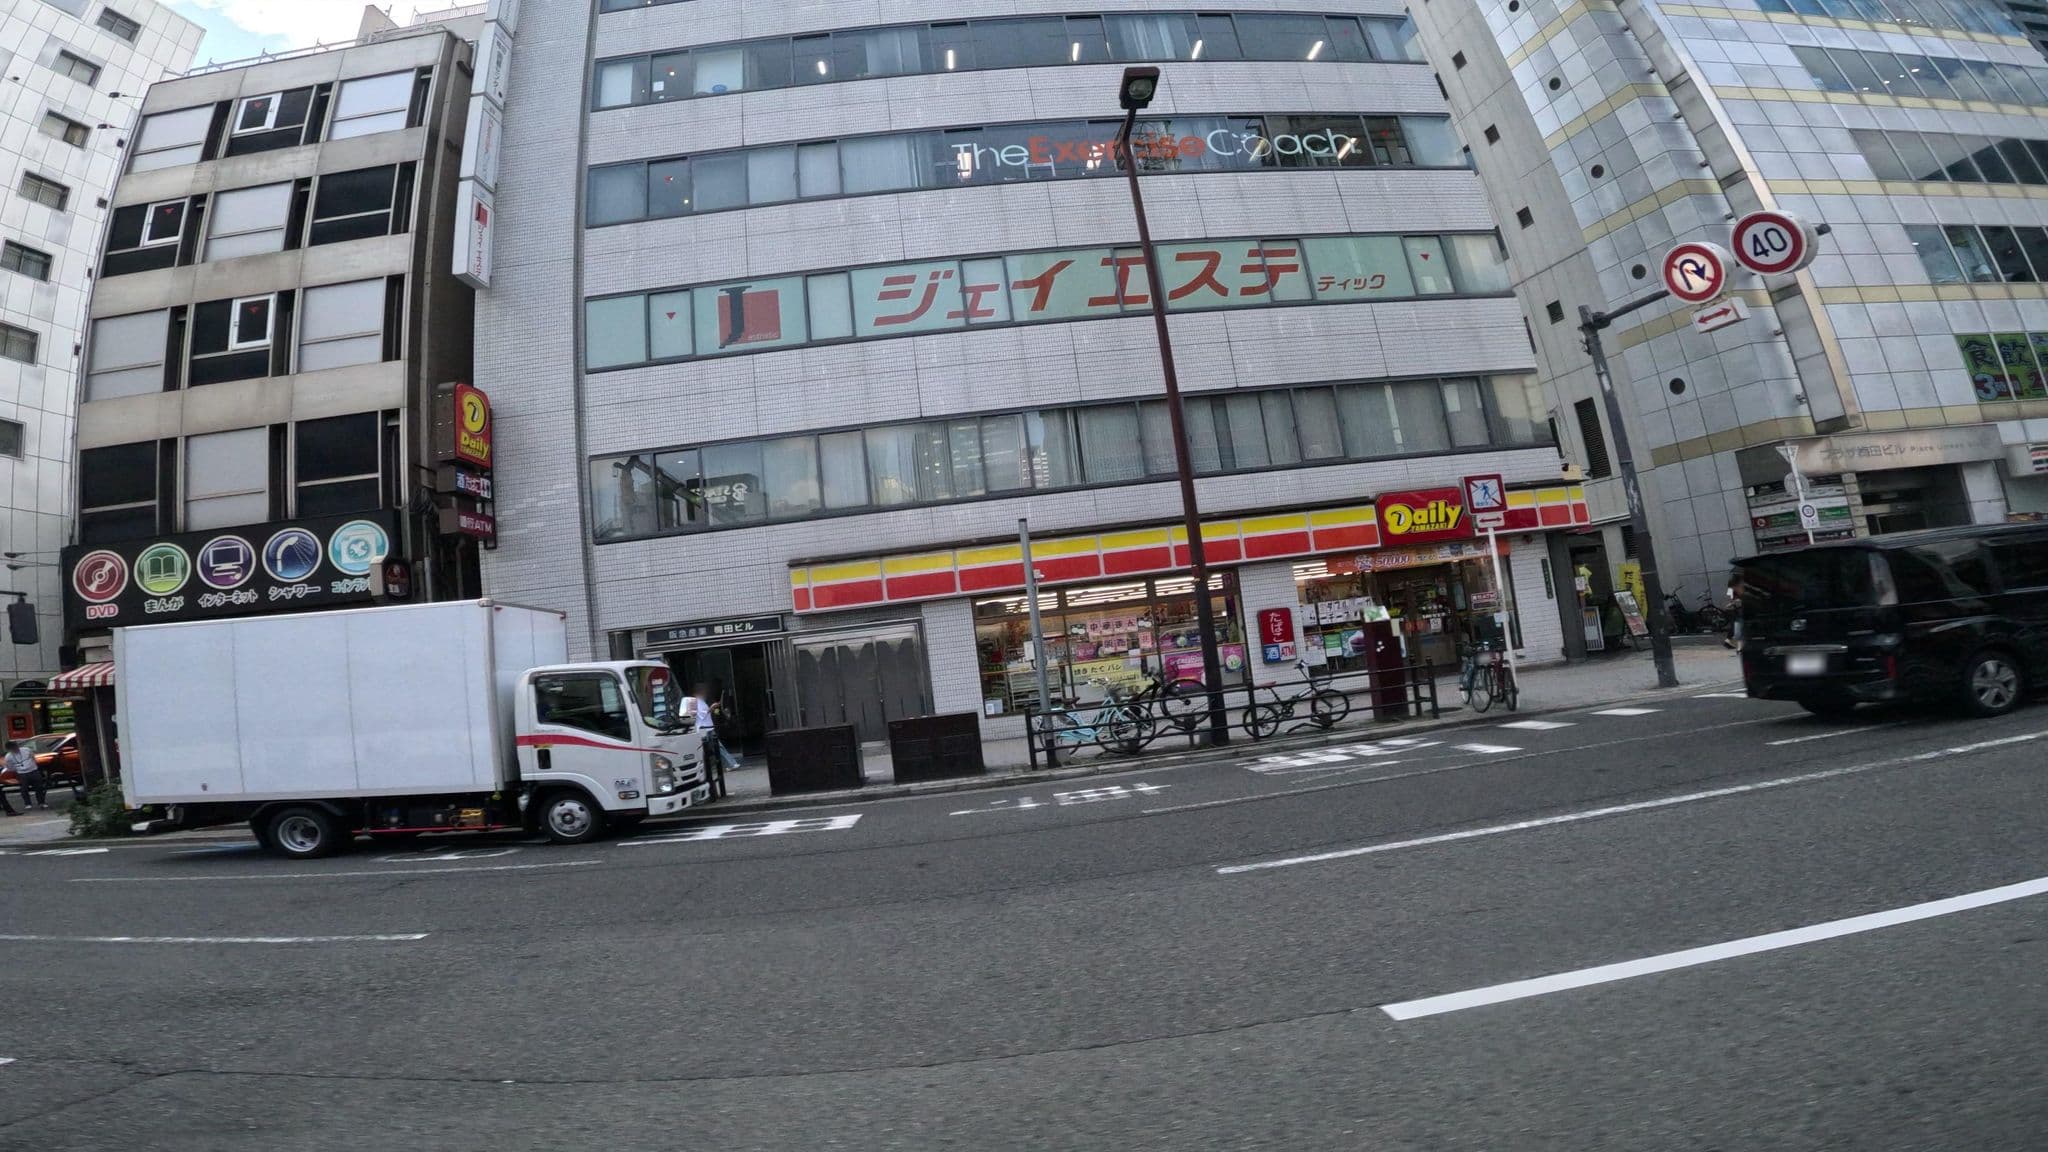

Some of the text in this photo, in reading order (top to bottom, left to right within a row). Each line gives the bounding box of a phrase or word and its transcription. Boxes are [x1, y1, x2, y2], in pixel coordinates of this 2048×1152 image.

[951, 128, 1356, 171] The Exercise Coach
[1752, 227, 1788, 258] 40
[1317, 273, 1386, 292] ティック
[461, 431, 489, 460] Daily
[1385, 500, 1463, 535] Daily
[1411, 522, 1448, 533] YAMAZAKI
[198, 589, 259, 608] インターネット
[268, 583, 322, 601] シャワー
[86, 603, 119, 620] DVD
[144, 597, 185, 614] まんが
[1269, 612, 1285, 643] たばこ
[1266, 645, 1280, 660] 酒
[1281, 646, 1296, 657] ATM
